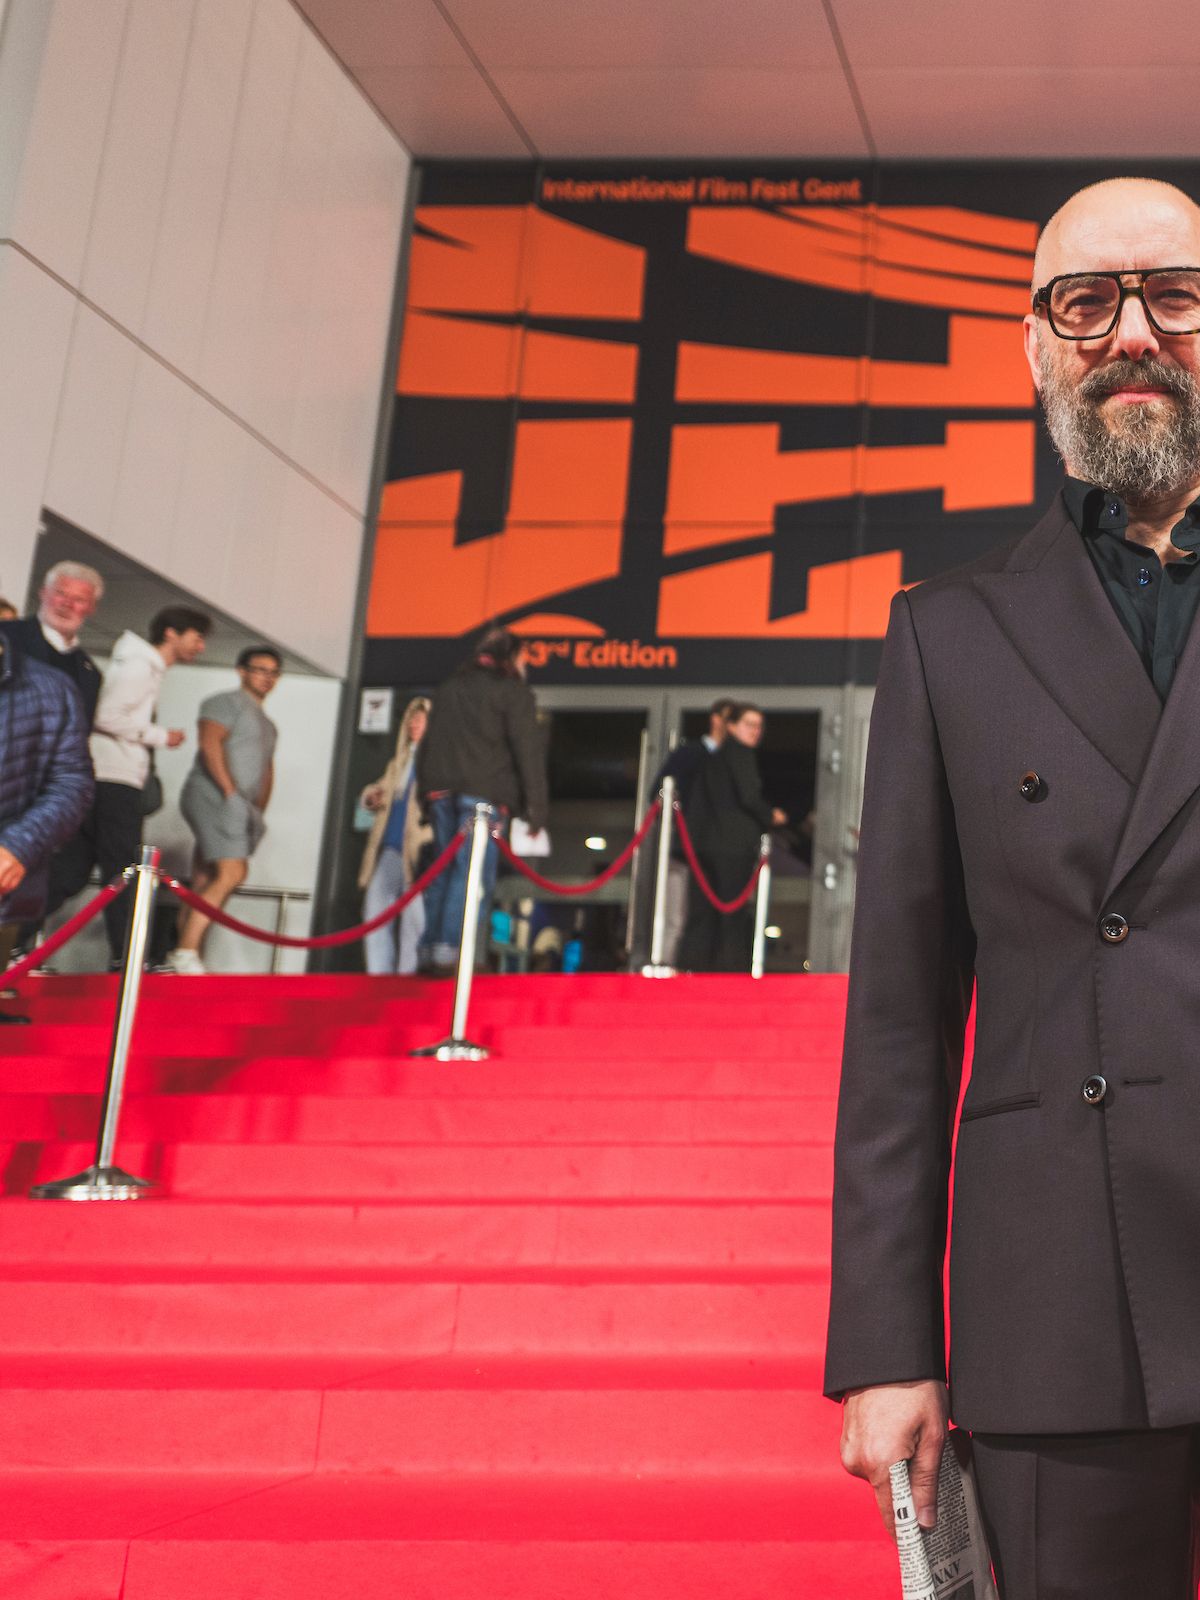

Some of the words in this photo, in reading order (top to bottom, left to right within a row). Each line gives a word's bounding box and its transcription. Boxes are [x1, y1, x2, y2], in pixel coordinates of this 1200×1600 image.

[543, 177, 696, 201] International
[700, 177, 748, 201] Film
[751, 178, 799, 201] Fest
[803, 178, 862, 201] Gent
[574, 638, 678, 668] Edition
